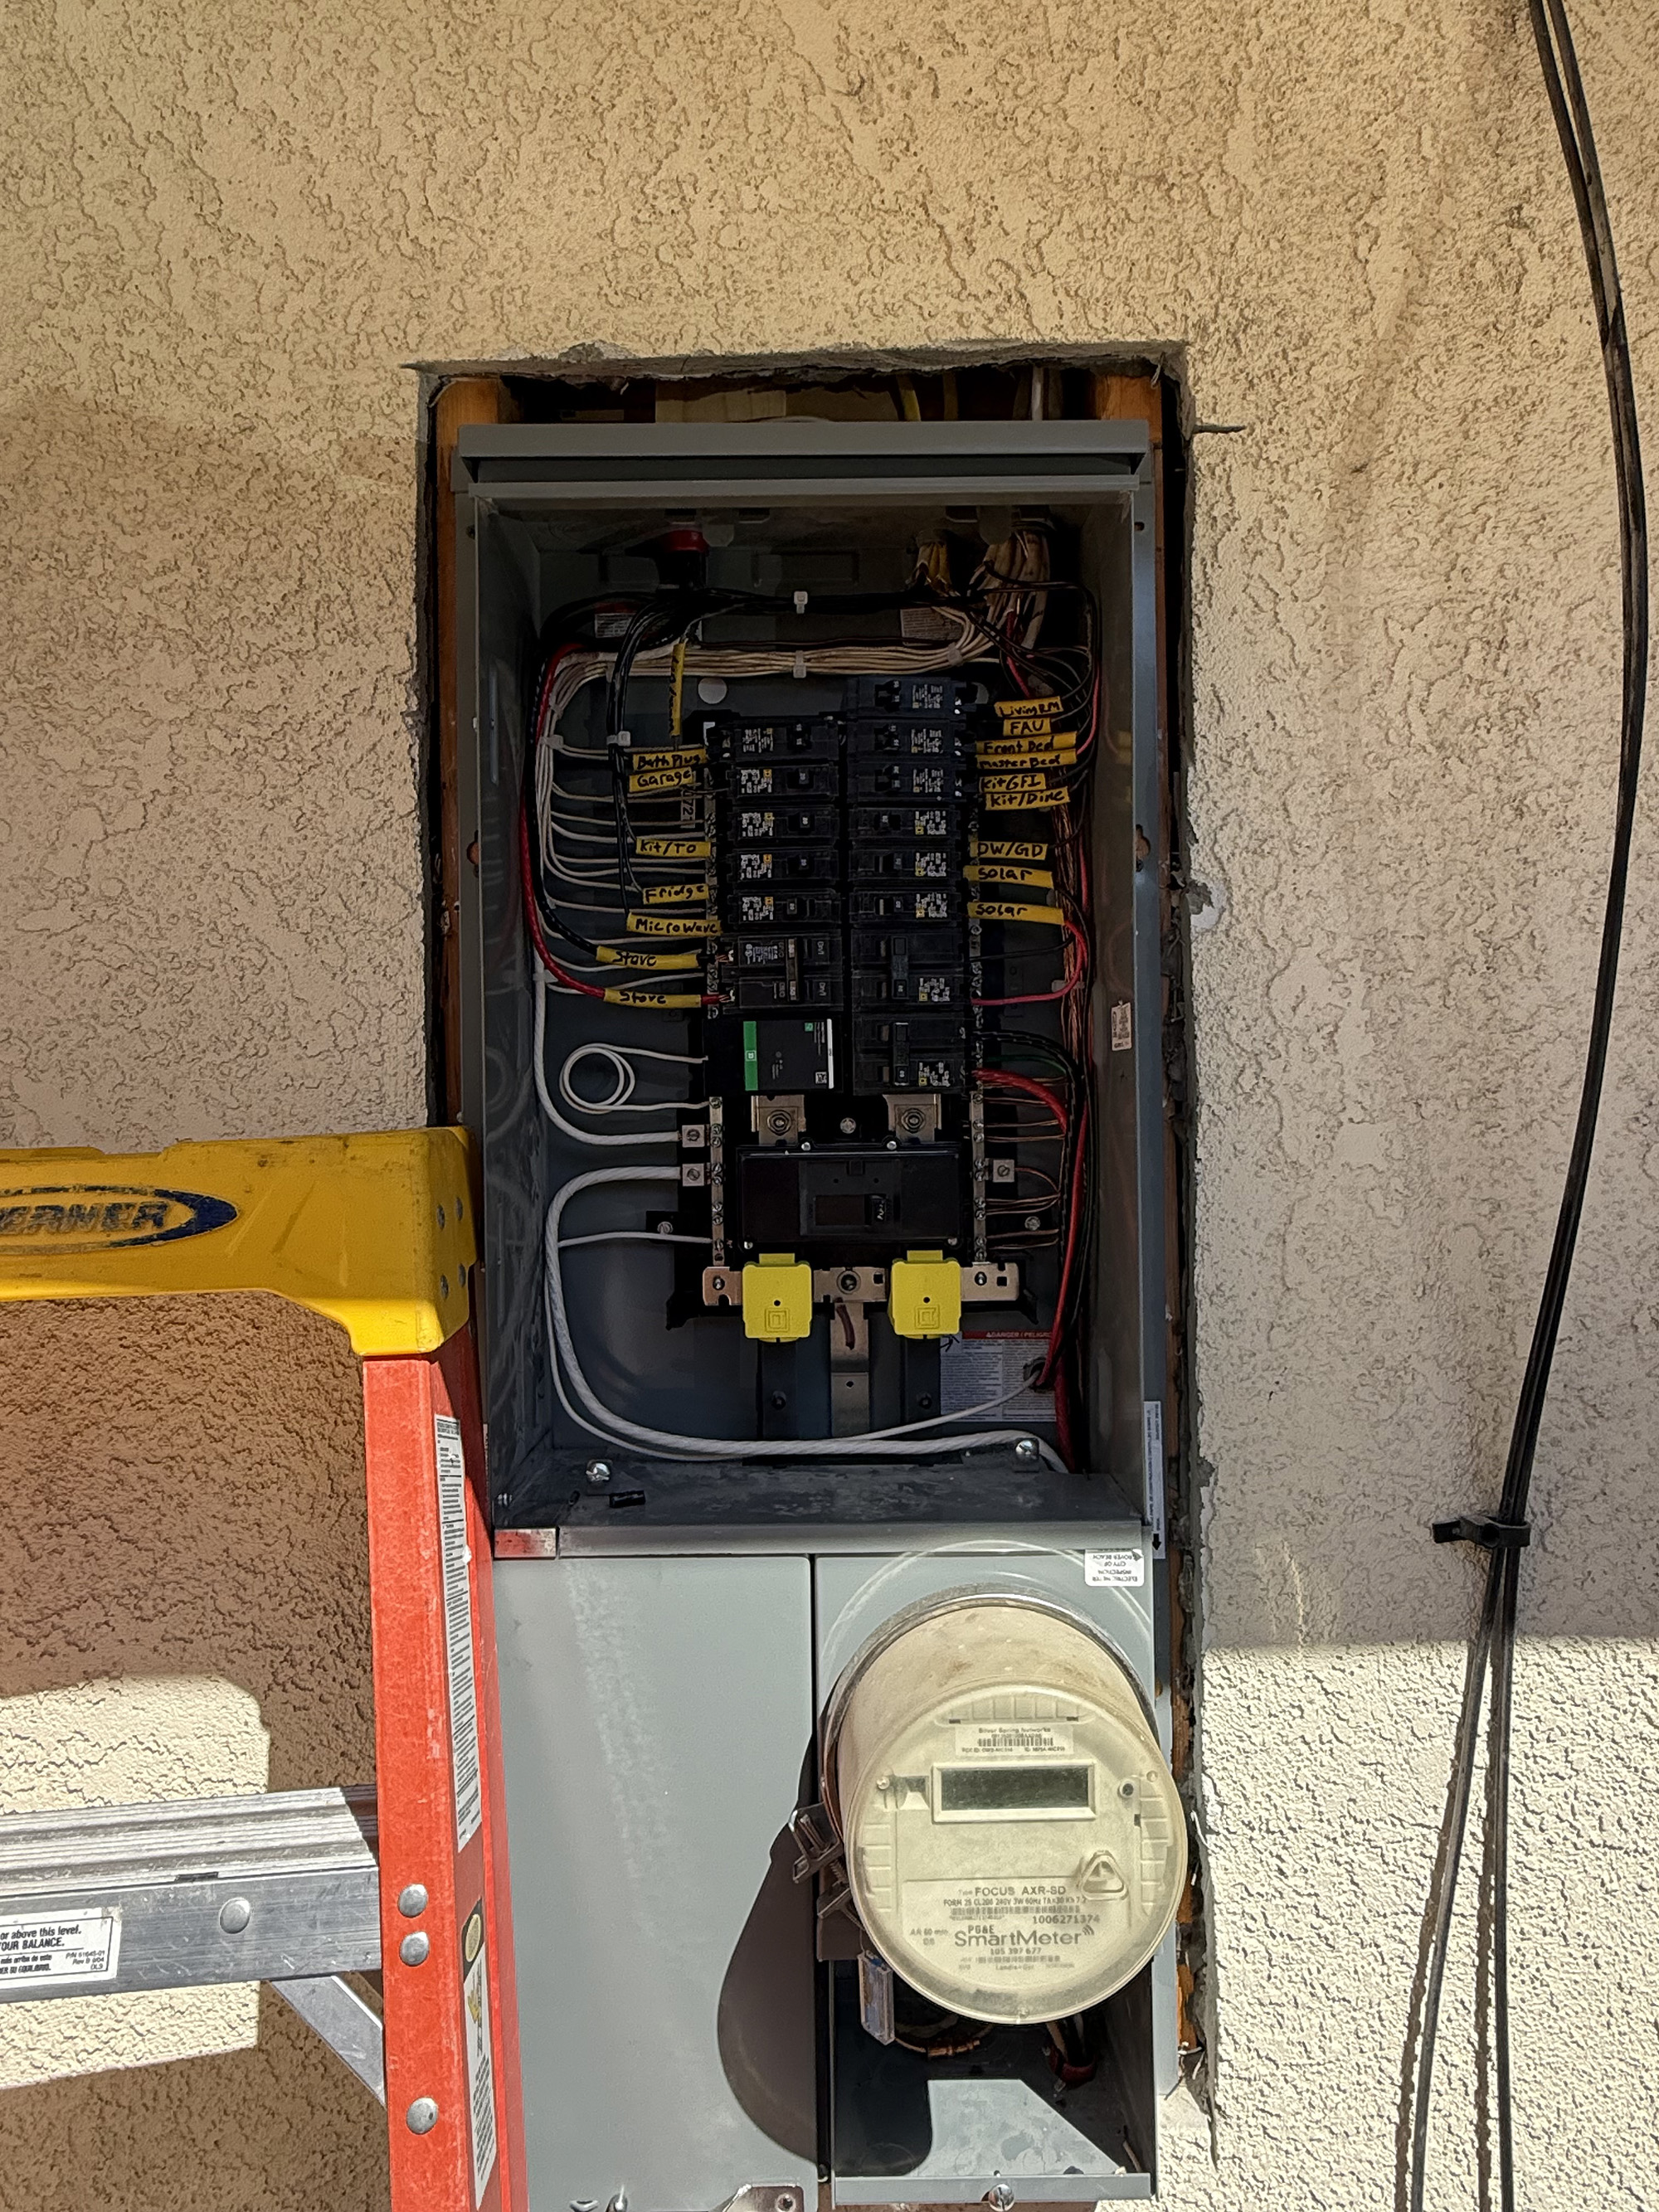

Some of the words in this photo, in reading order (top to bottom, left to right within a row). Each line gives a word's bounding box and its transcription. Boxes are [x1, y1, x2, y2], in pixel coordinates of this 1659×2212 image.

[1039, 701, 1060, 713] RM
[1010, 719, 1044, 735] FAU
[984, 741, 1023, 754] Front
[637, 754, 669, 770] Bath
[671, 754, 700, 768] Plug
[637, 770, 691, 787] Garage
[1006, 775, 1041, 790] GFI
[978, 842, 1043, 858] DW/GD
[645, 885, 705, 902] Fridge
[619, 990, 666, 1004] Stove
[975, 1887, 1015, 1896] FOCUS
[1022, 1886, 1066, 1895] AXR-SD
[1033, 1915, 1101, 1924] 1006271374
[12, 1929, 37, 1938] above
[40, 1927, 56, 1937] this
[58, 1924, 82, 1936] level.
[968, 1925, 995, 1934] PG&E
[0, 1941, 19, 1952] OUR
[22, 1937, 65, 1949] BALANCE.
[955, 1930, 1082, 1947] SmartMeter
